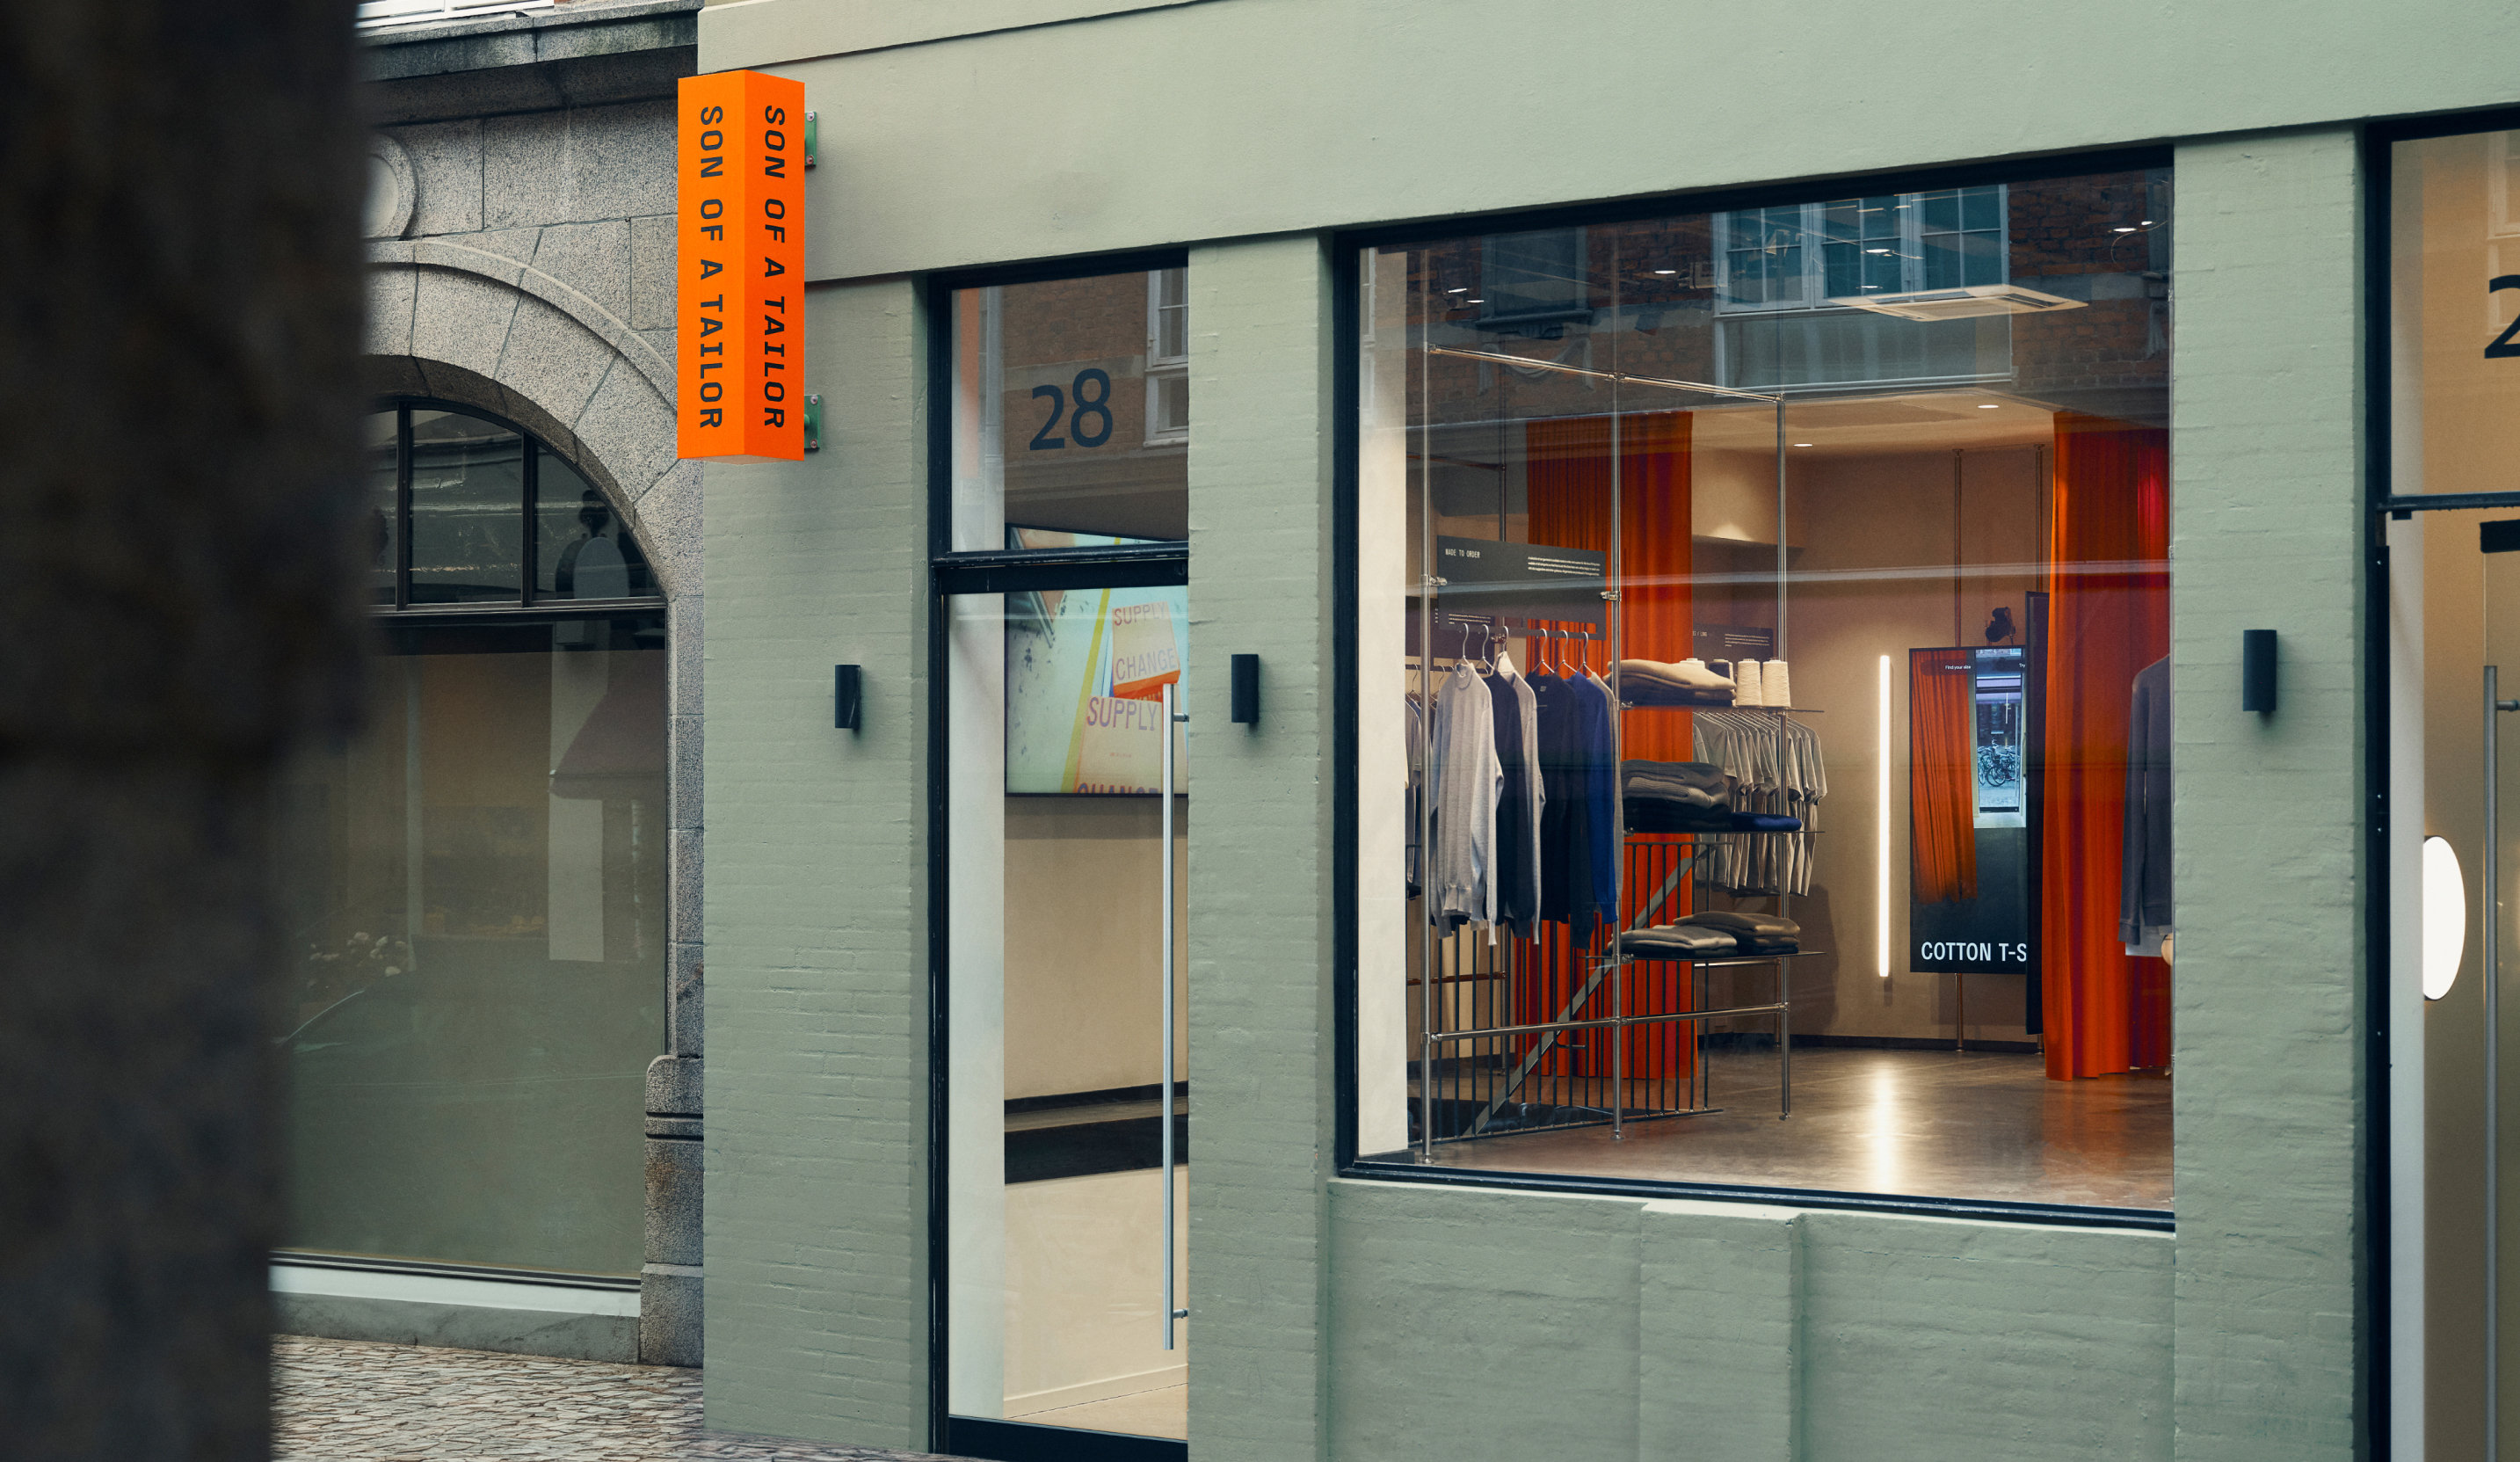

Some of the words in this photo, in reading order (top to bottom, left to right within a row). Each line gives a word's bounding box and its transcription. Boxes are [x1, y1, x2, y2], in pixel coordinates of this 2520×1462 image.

[700, 105, 723, 178] SON
[765, 105, 786, 179] SON
[700, 199, 723, 241] OF
[764, 198, 786, 244] OF
[700, 258, 723, 280] A
[764, 256, 786, 278] A
[700, 294, 723, 428] TAILOR
[764, 295, 786, 428] TAILOR
[1029, 367, 1113, 450] 28
[1466, 550, 1480, 559] ORDER
[1114, 601, 1166, 627] SUPPLY
[1115, 649, 1177, 680] CHANGE
[1087, 696, 1158, 731] SUPPLY
[1921, 942, 1991, 961] COTTON
[1999, 942, 2027, 962] T-S
